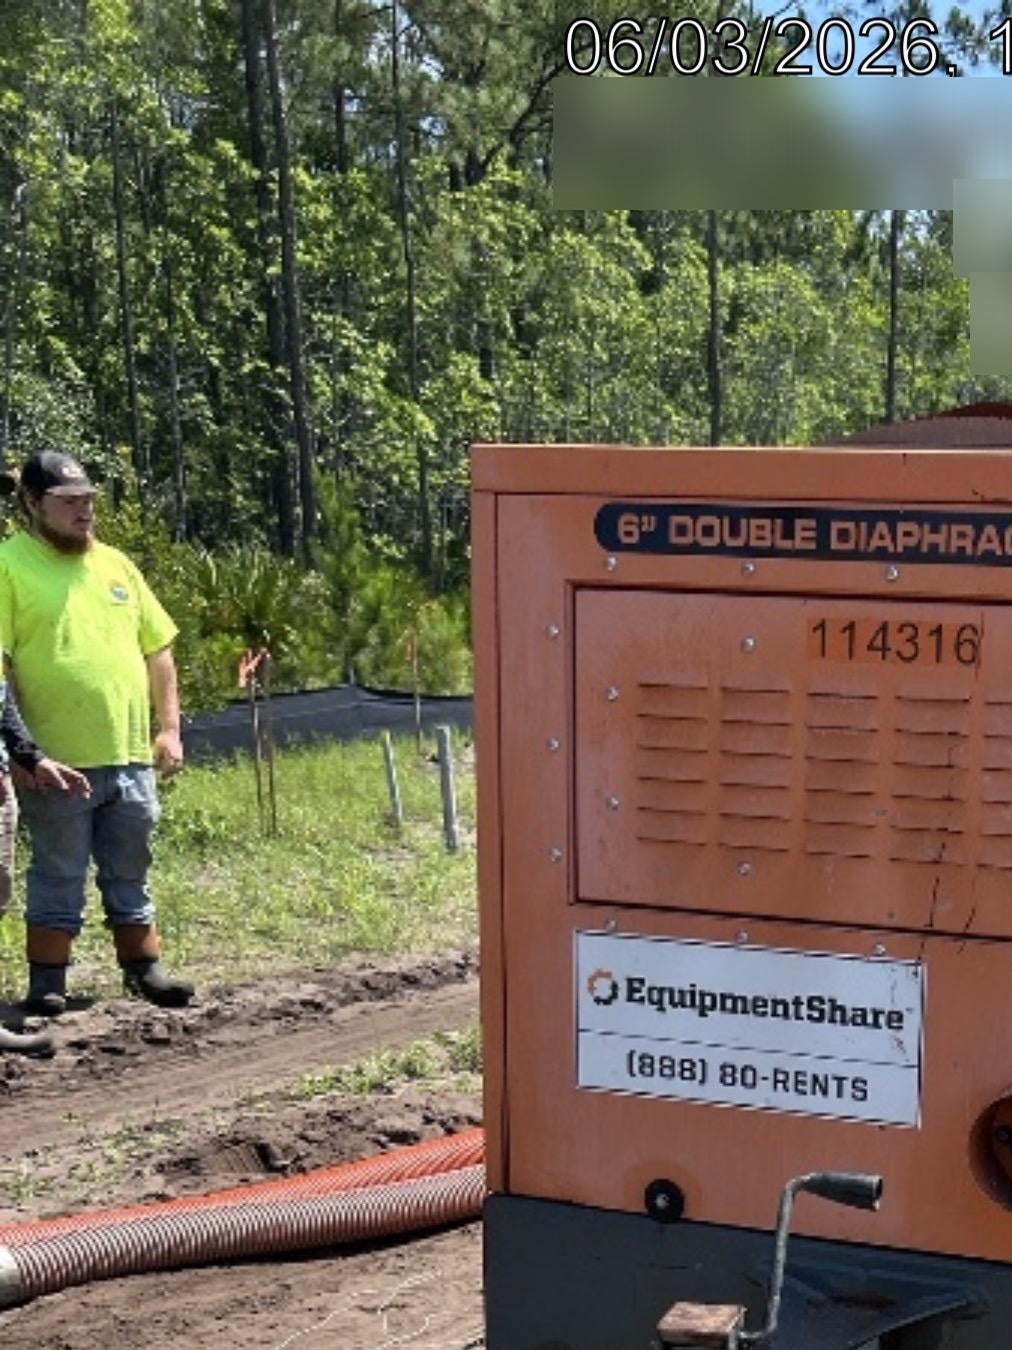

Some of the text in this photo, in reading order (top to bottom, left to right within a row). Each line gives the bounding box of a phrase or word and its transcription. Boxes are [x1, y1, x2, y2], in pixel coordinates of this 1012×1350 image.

[617, 513, 655, 545] 6"
[668, 515, 817, 550] DOUBLE
[812, 618, 980, 664] 114316
[625, 976, 904, 1030] EquipmentShare
[626, 1050, 868, 1102] (888) 80-RENTS
